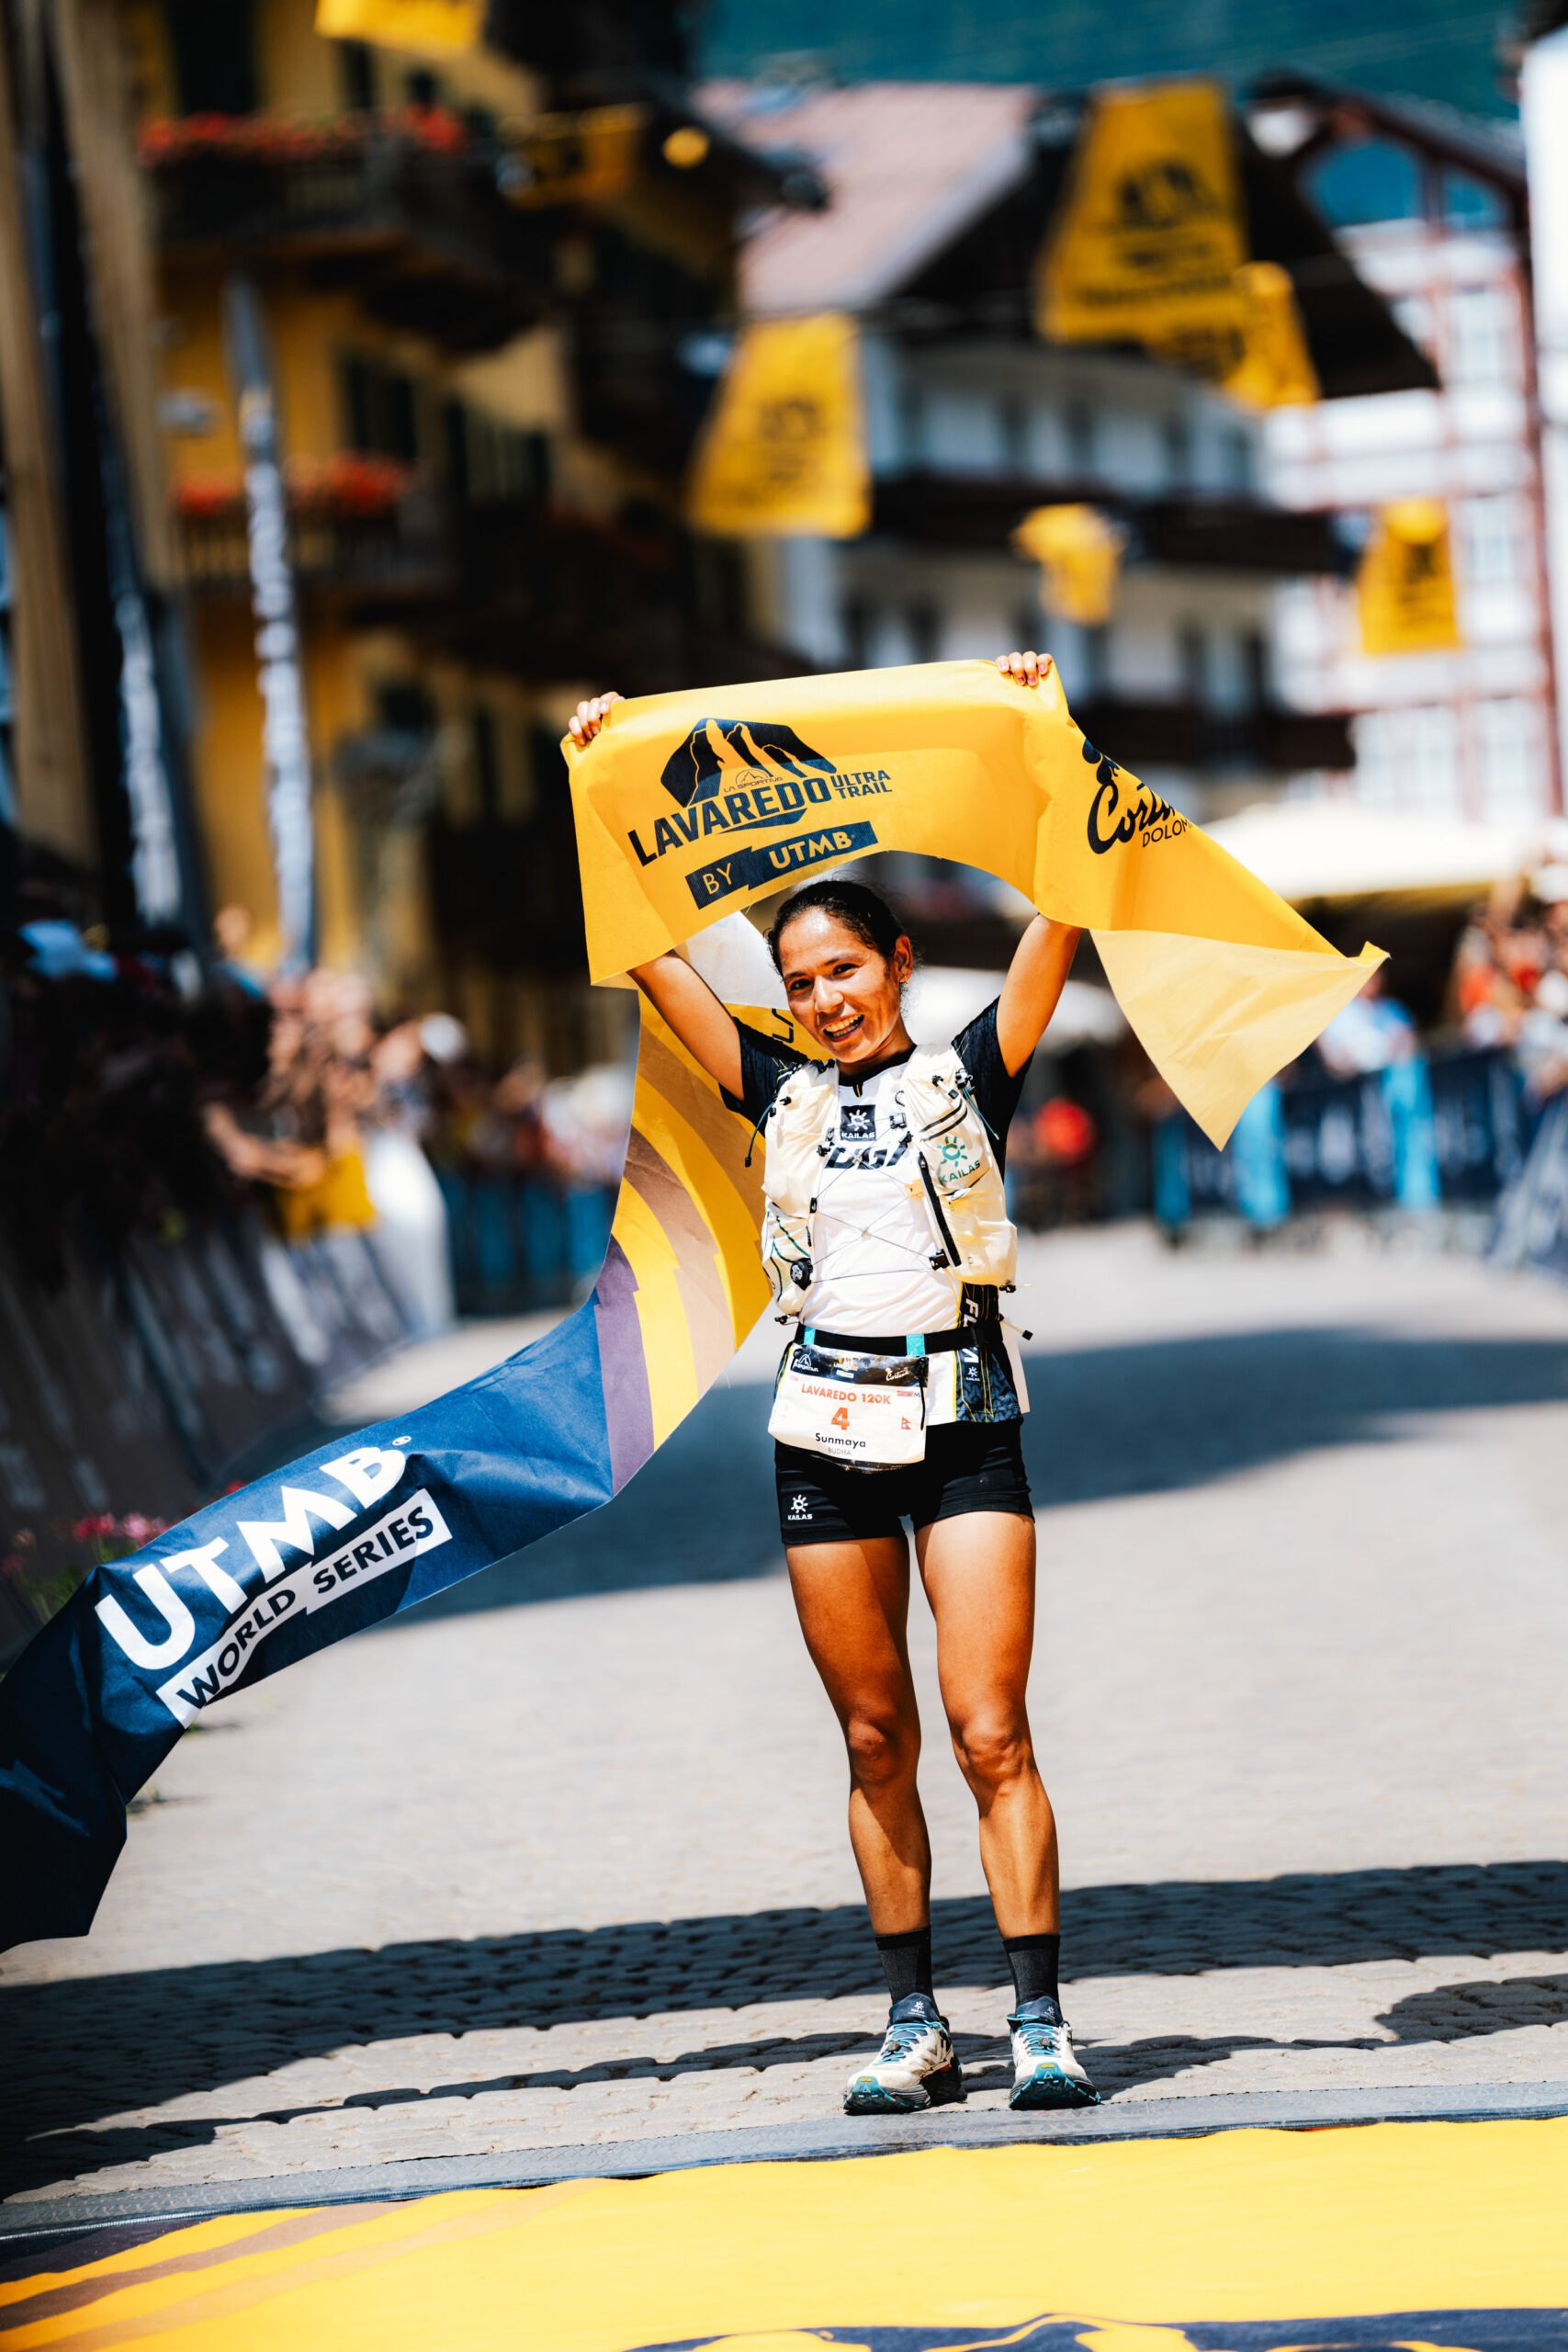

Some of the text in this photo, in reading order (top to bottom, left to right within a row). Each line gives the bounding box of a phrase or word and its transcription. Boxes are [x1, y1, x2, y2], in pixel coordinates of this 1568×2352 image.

[738, 776, 784, 789] SPORTIVA
[830, 770, 891, 788] ULTRA
[835, 782, 893, 799] TRAIL
[627, 777, 832, 866] LAVAREDO
[703, 831, 852, 895] BY UTMB
[840, 1132, 875, 1140] KAILAS
[939, 1159, 981, 1184] KAILAS
[801, 1383, 892, 1405] LAVAREDO 120K
[831, 1407, 851, 1430] 4
[815, 1432, 866, 1449] Sunmaya
[828, 1447, 852, 1456] BUDHA
[176, 1506, 434, 1710] WORLD SERIES
